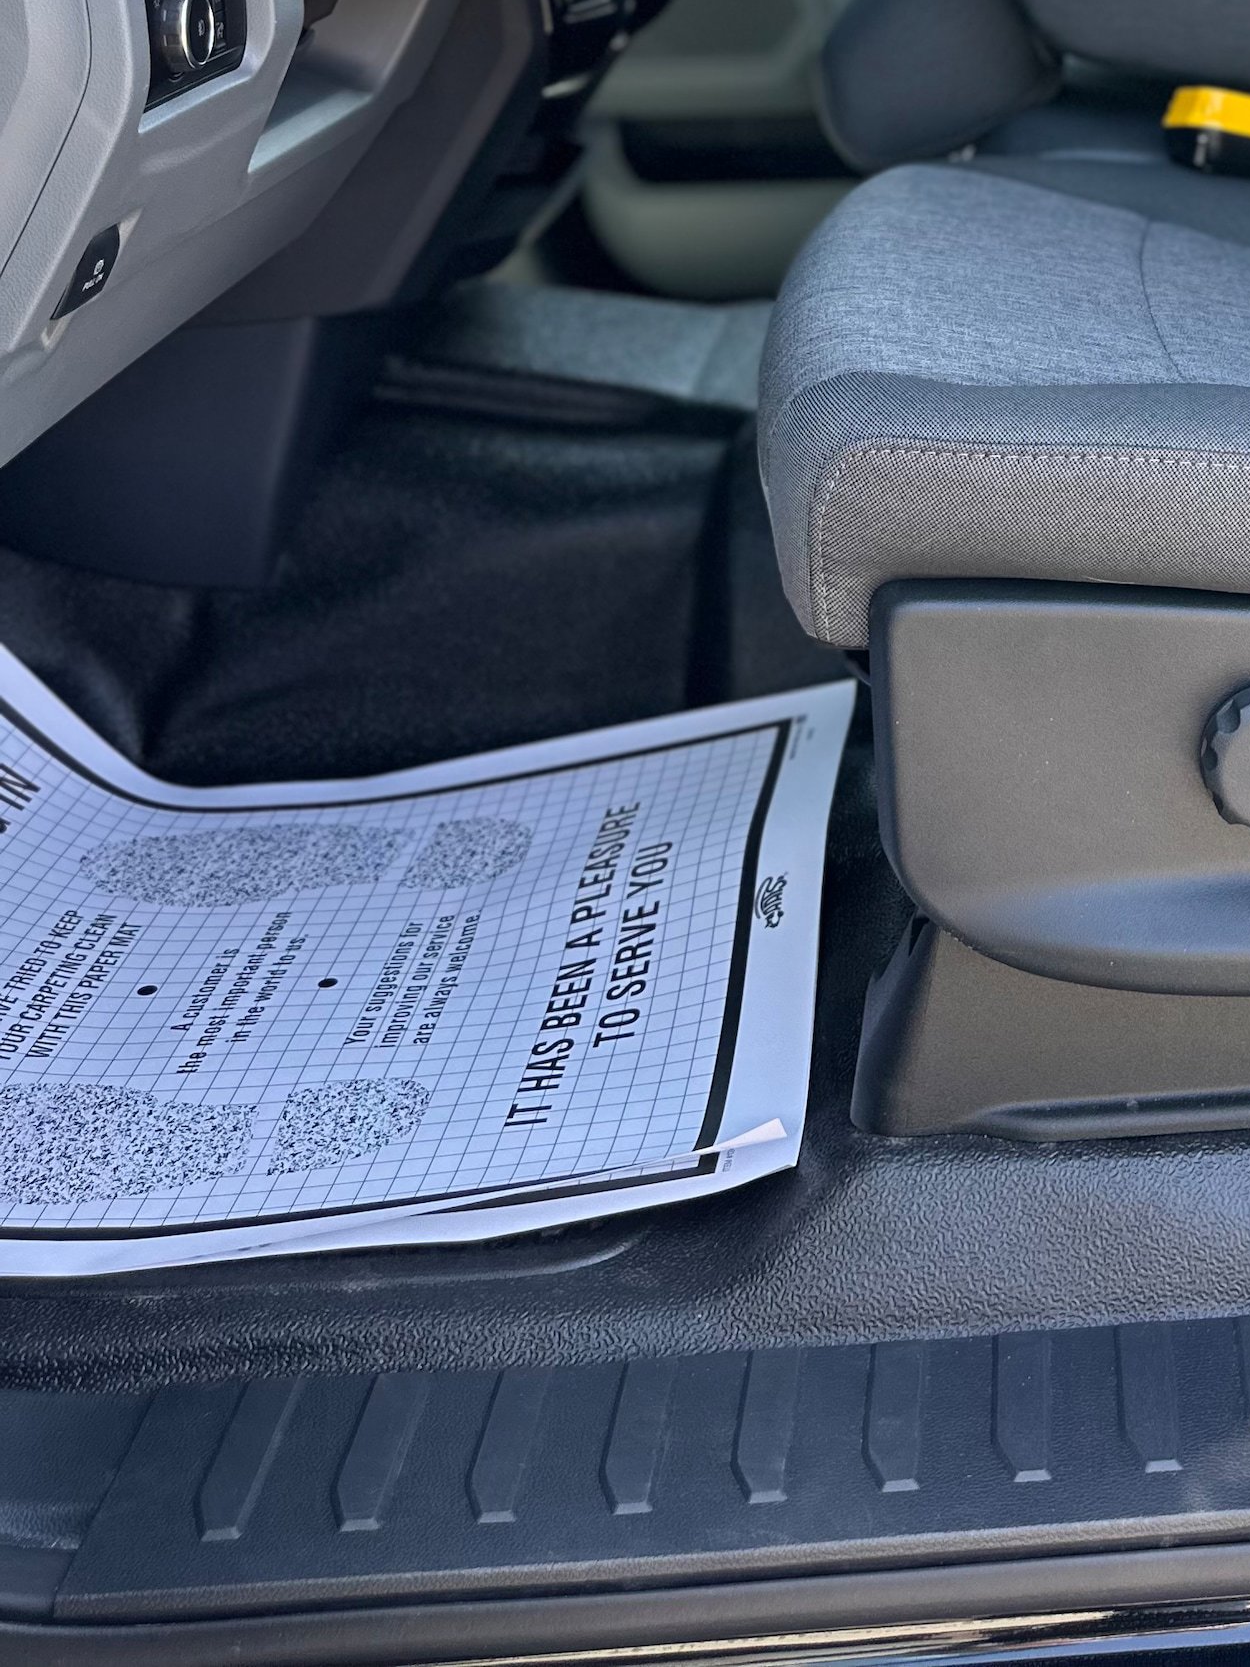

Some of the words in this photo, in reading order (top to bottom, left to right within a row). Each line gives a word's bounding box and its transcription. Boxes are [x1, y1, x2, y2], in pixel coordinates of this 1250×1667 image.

[571, 802, 641, 924] PLEASURE
[626, 841, 673, 899] YOU
[4, 957, 47, 991] TRIED
[33, 939, 62, 955] TO
[48, 910, 84, 939] KEEP
[256, 911, 293, 951] person
[285, 934, 309, 952] us.
[445, 909, 482, 976] welcome.
[565, 927, 603, 949] A
[606, 900, 660, 1001] SERVE
[20, 953, 88, 1022] CARPETING
[74, 914, 118, 951] CLEAN
[213, 953, 268, 1011] important
[273, 954, 296, 966] to
[344, 1016, 377, 1045] Your
[366, 941, 415, 1012] suggestions
[400, 922, 423, 938] for
[374, 985, 427, 1049] improving
[412, 962, 434, 981] our
[423, 915, 455, 959] service
[25, 1022, 70, 1059] WITH
[53, 992, 93, 1020] THIS
[78, 950, 125, 989] PAPER
[109, 922, 142, 947] MAT
[170, 1022, 194, 1032] A
[183, 963, 231, 1020] customer
[216, 948, 240, 959] is
[254, 969, 288, 1003] world
[423, 976, 459, 1018] always
[540, 958, 597, 1031] BEEN
[197, 1015, 230, 1047] most
[225, 1030, 251, 1043] in
[236, 1006, 265, 1027] the
[413, 1023, 436, 1045] are
[593, 1008, 640, 1048] TO
[176, 1051, 208, 1074] the
[517, 1038, 575, 1093] HAS
[503, 1103, 553, 1127] IT
